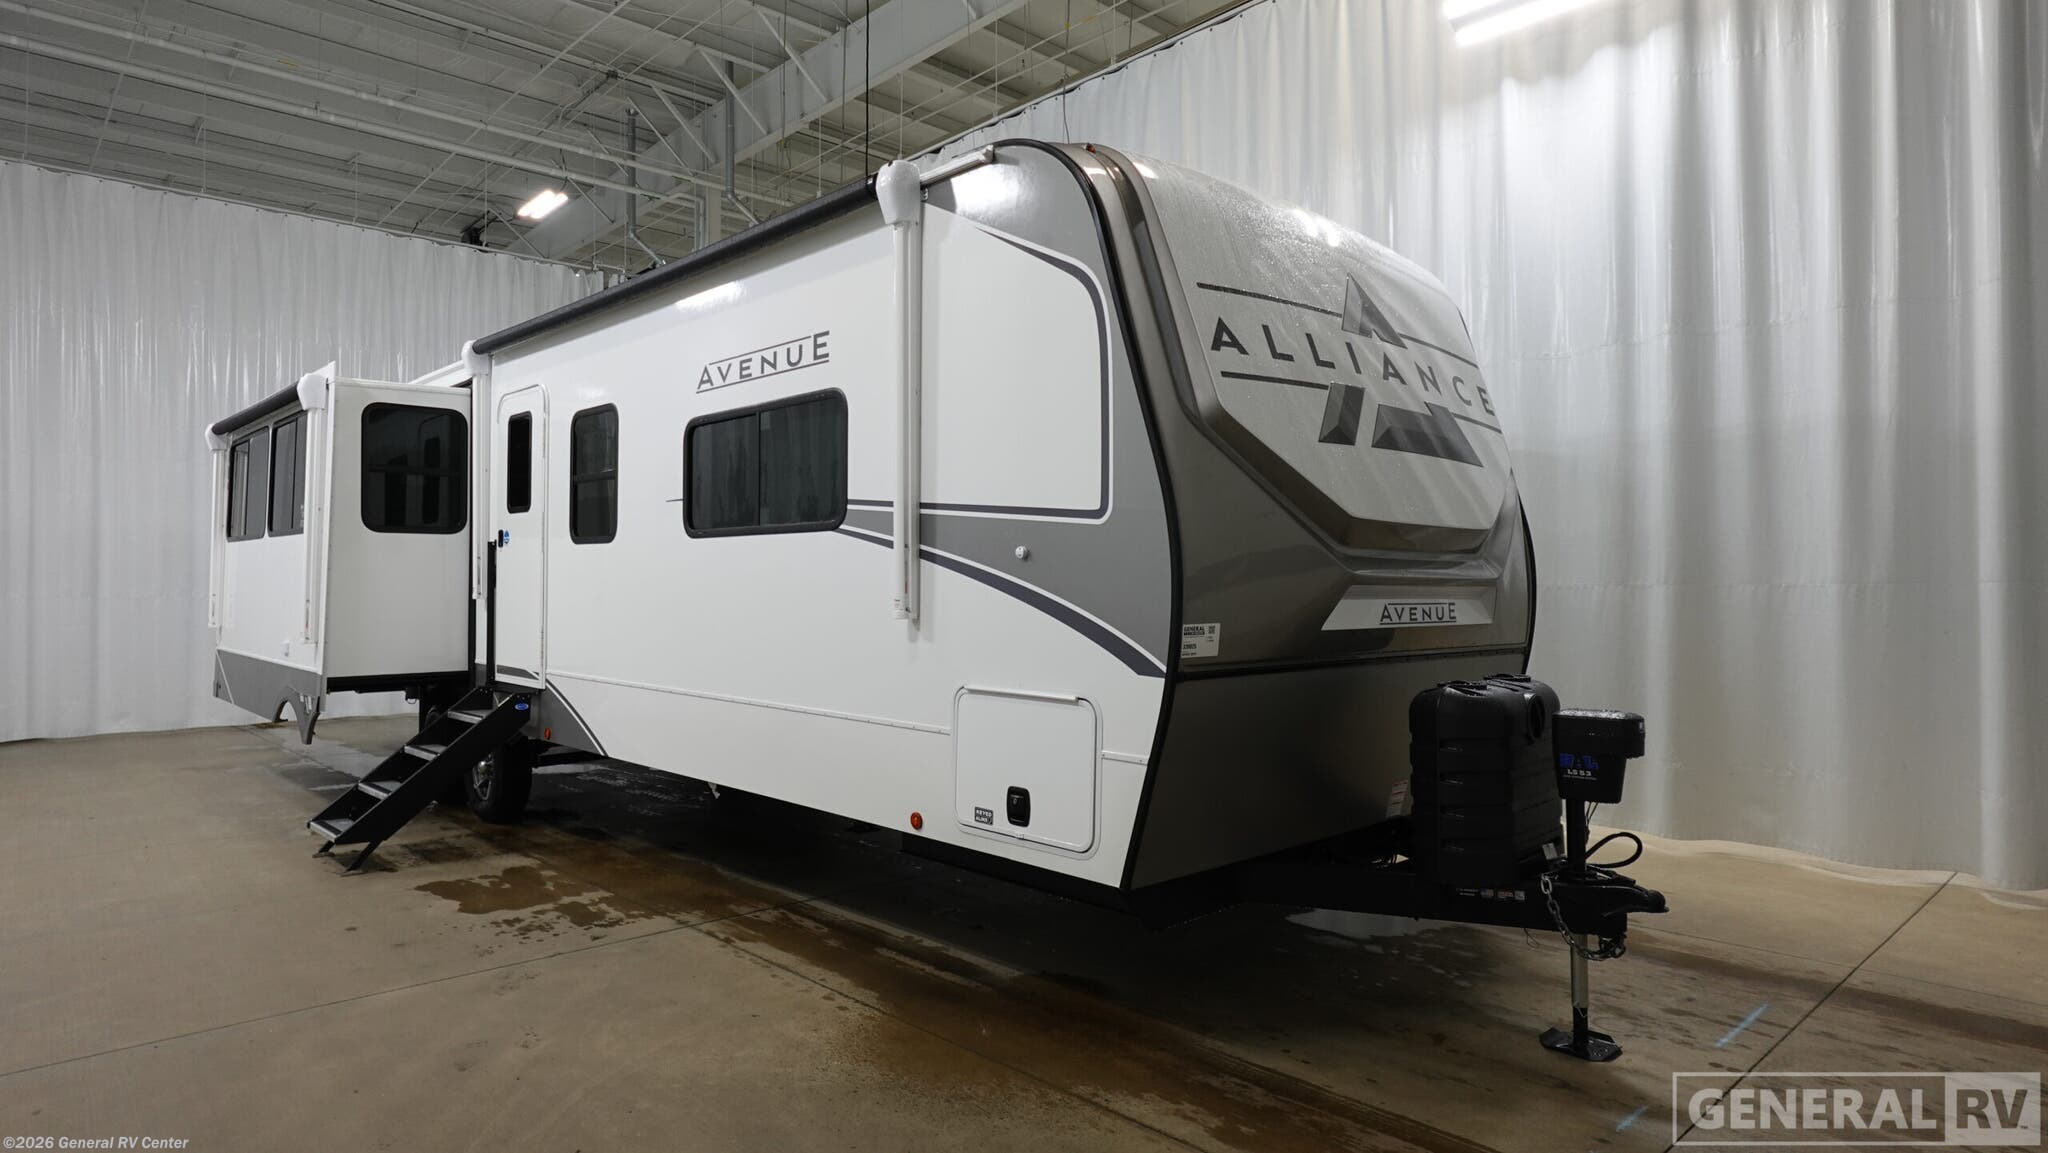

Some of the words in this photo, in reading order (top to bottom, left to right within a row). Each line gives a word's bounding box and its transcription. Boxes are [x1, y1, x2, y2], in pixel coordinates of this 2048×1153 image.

[697, 330, 830, 390] AVENUE
[1210, 316, 1496, 417] ALLIANCE
[1379, 602, 1457, 623] AVENUE
